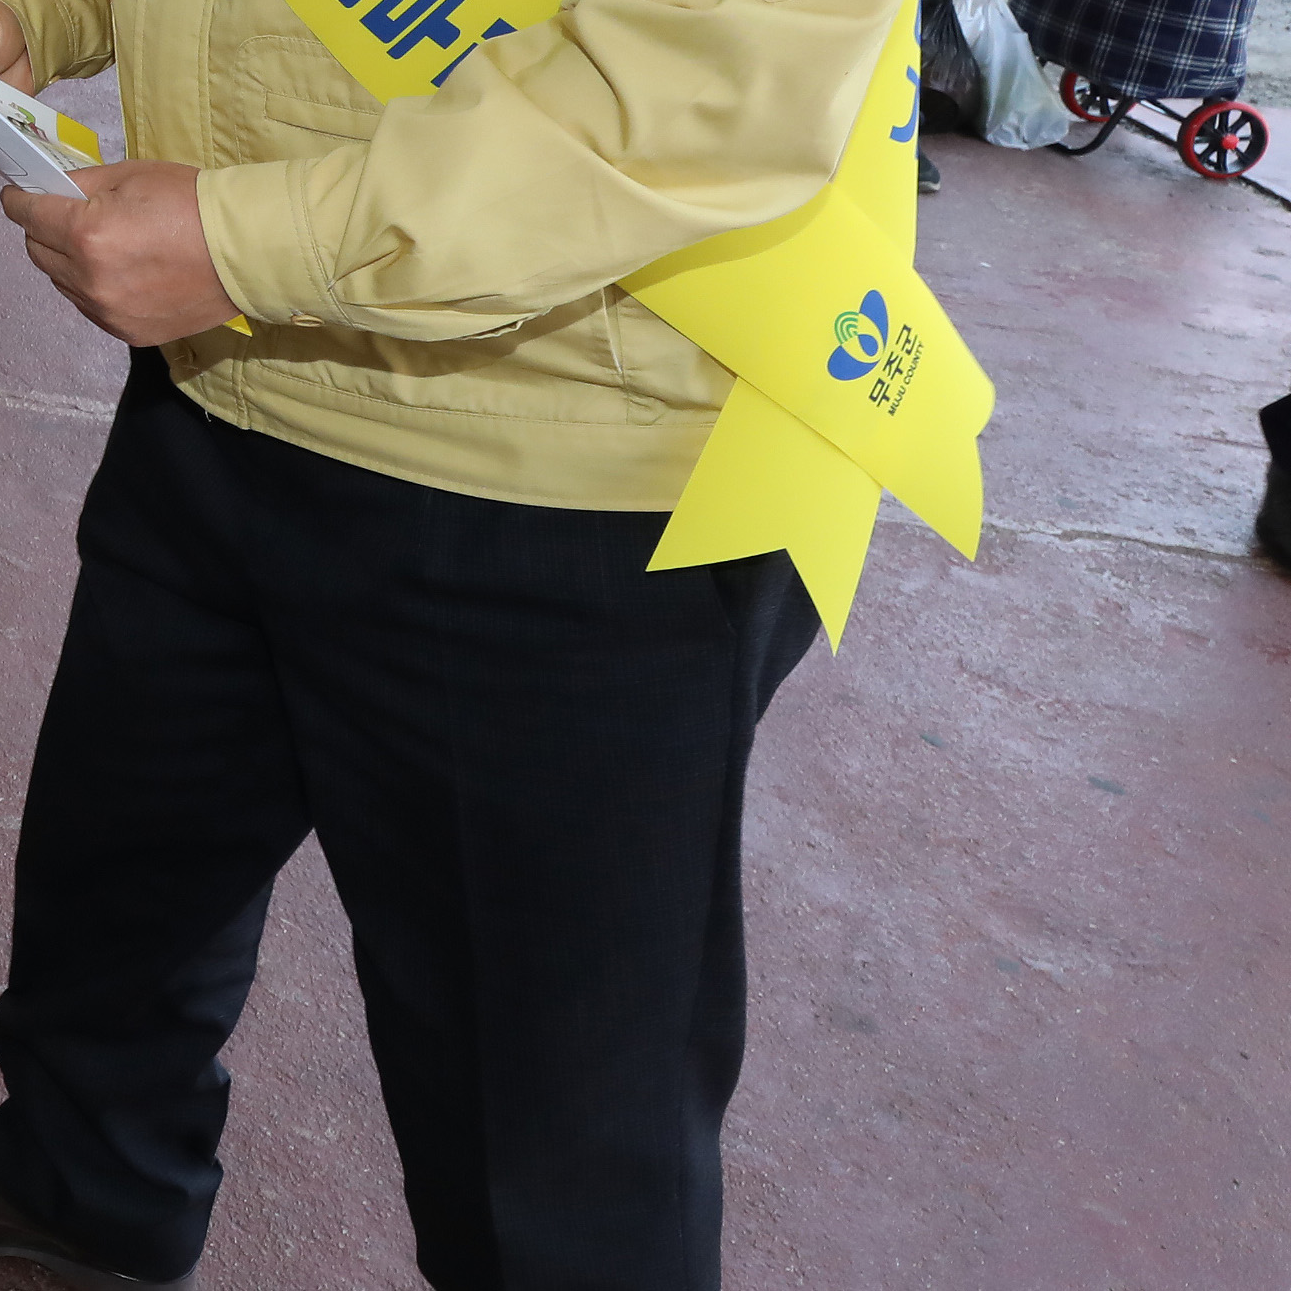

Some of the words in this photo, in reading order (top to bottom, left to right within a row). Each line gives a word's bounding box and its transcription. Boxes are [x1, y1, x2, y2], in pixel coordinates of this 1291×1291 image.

[868, 324, 918, 407] 무주군
[888, 385, 907, 416] MUJU
[903, 341, 924, 385] COUNTY
